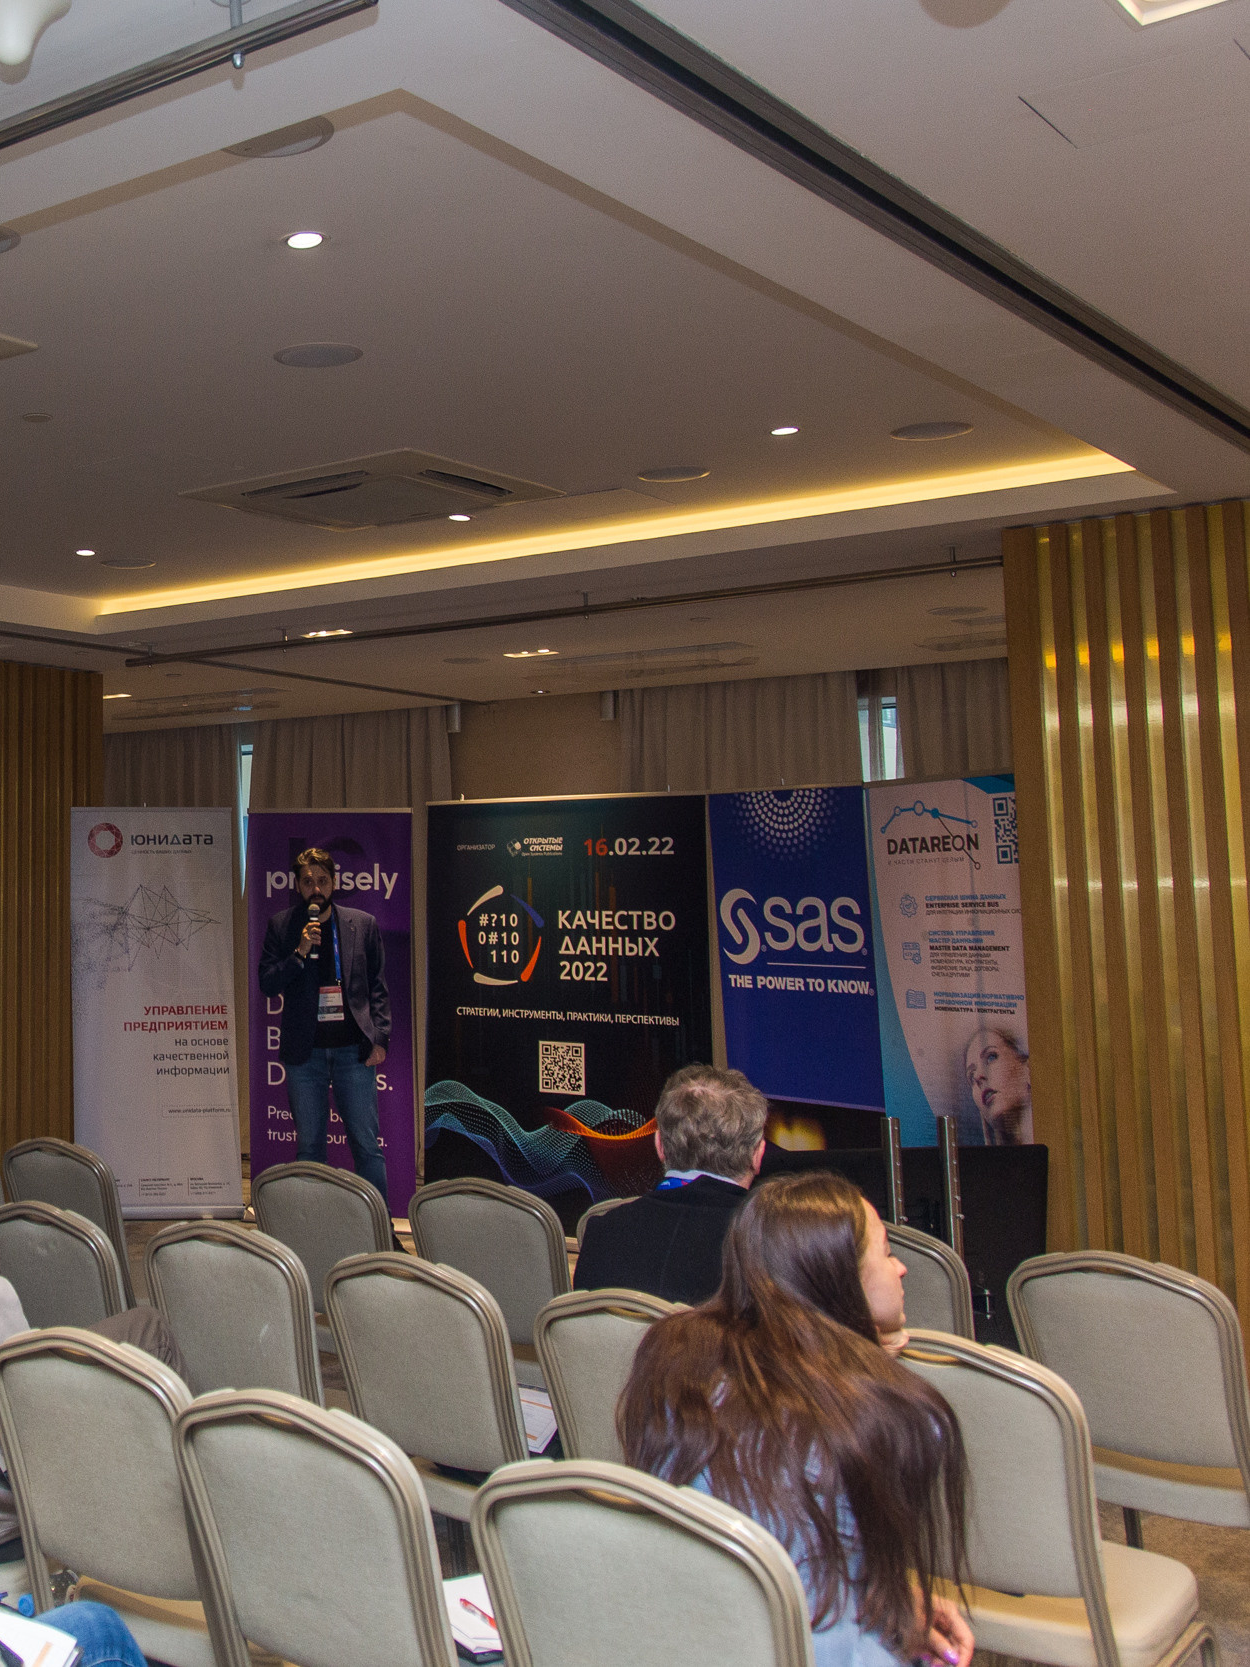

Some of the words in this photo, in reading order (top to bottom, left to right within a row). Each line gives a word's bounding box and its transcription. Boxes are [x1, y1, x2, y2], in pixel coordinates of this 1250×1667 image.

[456, 843, 496, 851] ОРГАНИЗАТОР
[523, 837, 563, 845] ОТКРЫТЫЕ
[529, 844, 563, 852] СИСТЕМЫ
[584, 836, 675, 856] 16.02.22
[887, 833, 980, 855] DATAREON
[266, 863, 399, 900] prisely
[479, 913, 519, 927] #?10
[558, 910, 676, 931] КАЧЕСТВО
[763, 896, 865, 953] sas
[478, 931, 520, 945] 0#10
[558, 936, 660, 957] ДАННЫХ
[490, 950, 520, 963] 110
[559, 961, 608, 982] 2022
[728, 974, 753, 988] THE
[756, 976, 805, 991] POWER
[806, 978, 825, 992] TO
[144, 1005, 228, 1016] УПРАВЛЕНИЕ
[456, 1006, 502, 1019] СТРАТЕГИИ,
[502, 1008, 566, 1022] ИНСТРУМЕНТЫ,
[566, 1011, 614, 1024] ПРАКТИКИ,
[615, 1014, 680, 1026] ПЕРСПЕКТИВЫ
[123, 1020, 228, 1033] ПРЕДПРИЯТИЕМ
[174, 1038, 188, 1046] на
[190, 1037, 229, 1046] основе
[153, 1050, 230, 1061] качественной
[156, 1065, 230, 1077] информации
